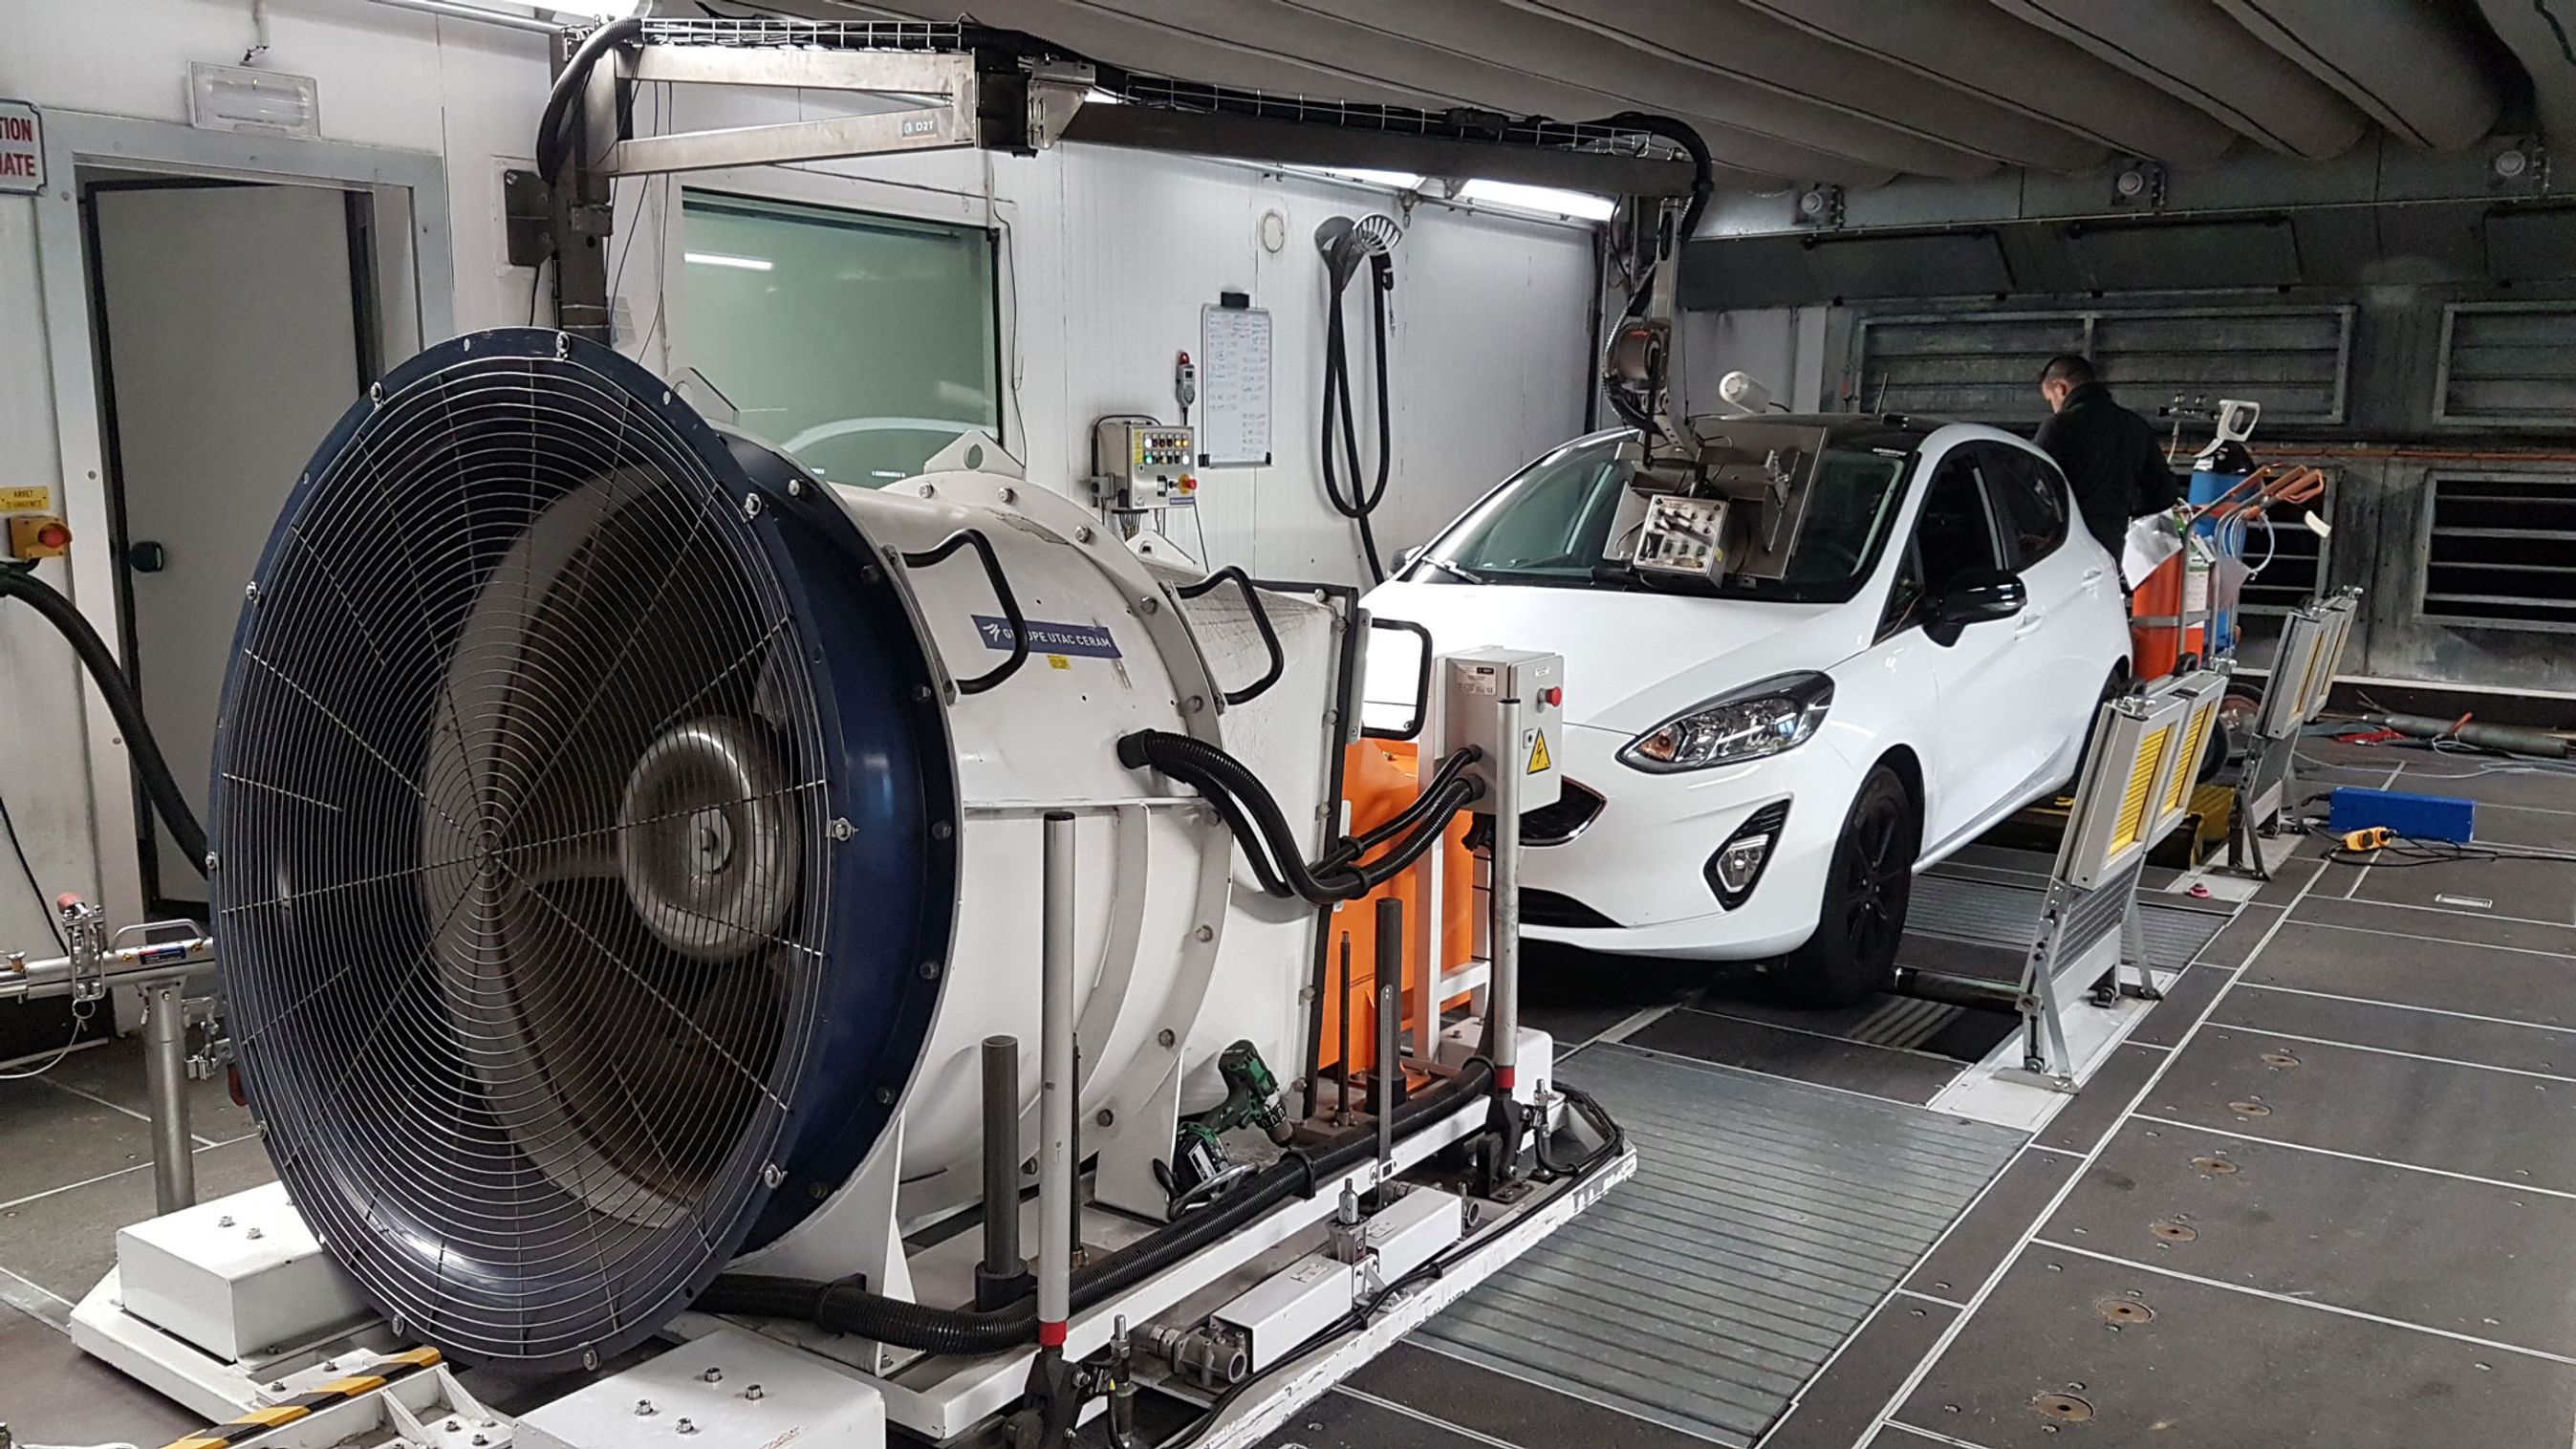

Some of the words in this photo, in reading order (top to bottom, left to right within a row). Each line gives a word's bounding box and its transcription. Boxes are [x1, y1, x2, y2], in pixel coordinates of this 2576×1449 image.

[916, 120, 933, 132] D2T
[1047, 632, 1075, 645] UTAC
[1075, 635, 1112, 648] CERAM
